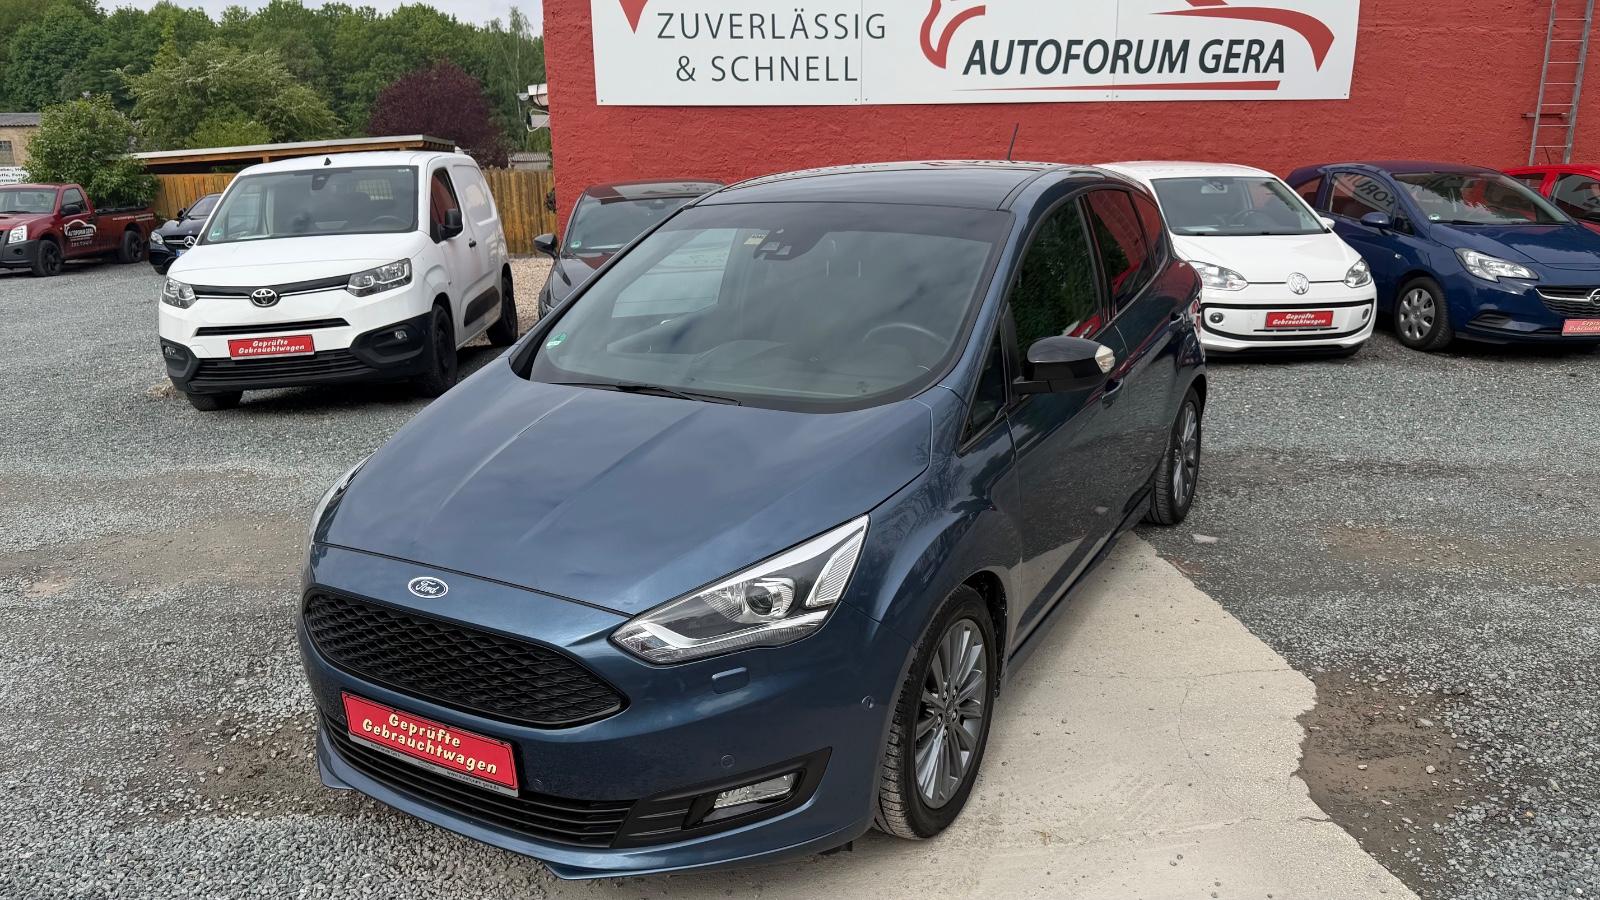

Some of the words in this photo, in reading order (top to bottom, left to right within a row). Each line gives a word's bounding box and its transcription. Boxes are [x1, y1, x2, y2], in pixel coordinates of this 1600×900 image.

[657, 8, 886, 40] ZUVERLÄSSIG
[676, 55, 696, 82] &
[711, 55, 858, 82] SCHNELL
[962, 39, 1190, 75] AUTOFORUM
[1198, 39, 1285, 73] GERA
[238, 345, 305, 354] Gebrauchtwagen
[252, 339, 288, 348] Geprüfte
[415, 580, 439, 594] Ford
[388, 713, 461, 748] Geprüfte
[362, 718, 497, 775] Gebrauchtwagen
